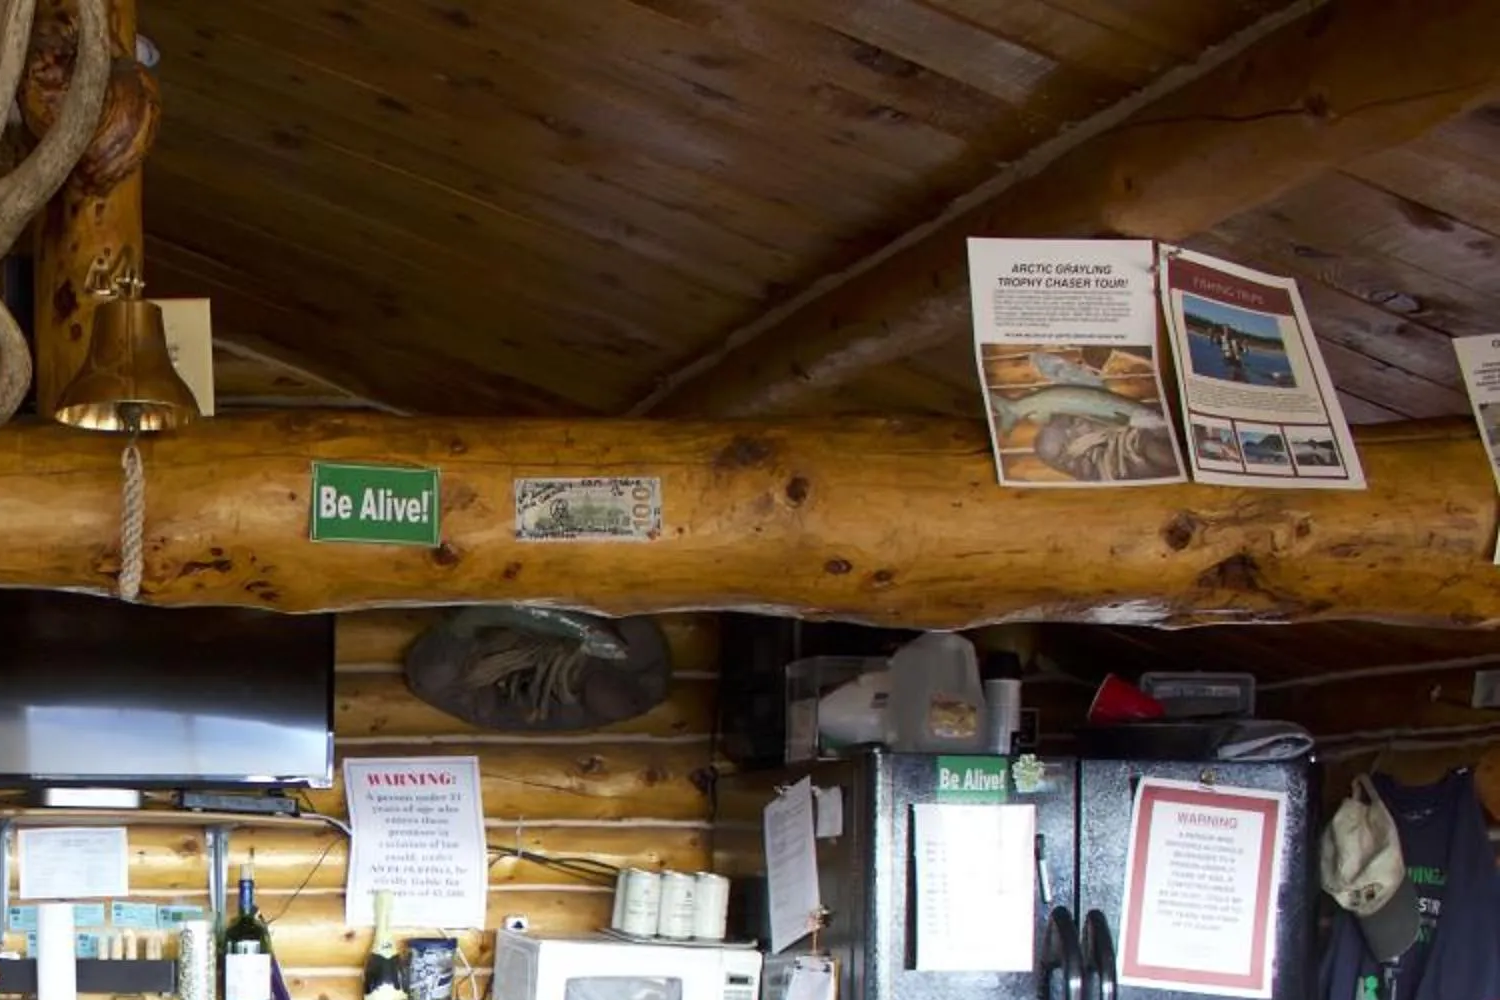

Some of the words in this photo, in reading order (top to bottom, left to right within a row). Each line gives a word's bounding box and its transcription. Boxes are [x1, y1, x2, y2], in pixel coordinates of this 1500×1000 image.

[1011, 263, 1053, 274] ARCTIC
[1056, 263, 1112, 275] GRAYLING
[997, 277, 1042, 288] TROPHY
[1045, 278, 1091, 289] CHASER
[319, 485, 352, 519] Be
[359, 487, 429, 524] Alive!
[366, 772, 457, 786] WARNING:
[939, 767, 960, 789] Be
[963, 768, 1005, 791] Alive!
[1177, 811, 1238, 830] WARNING
